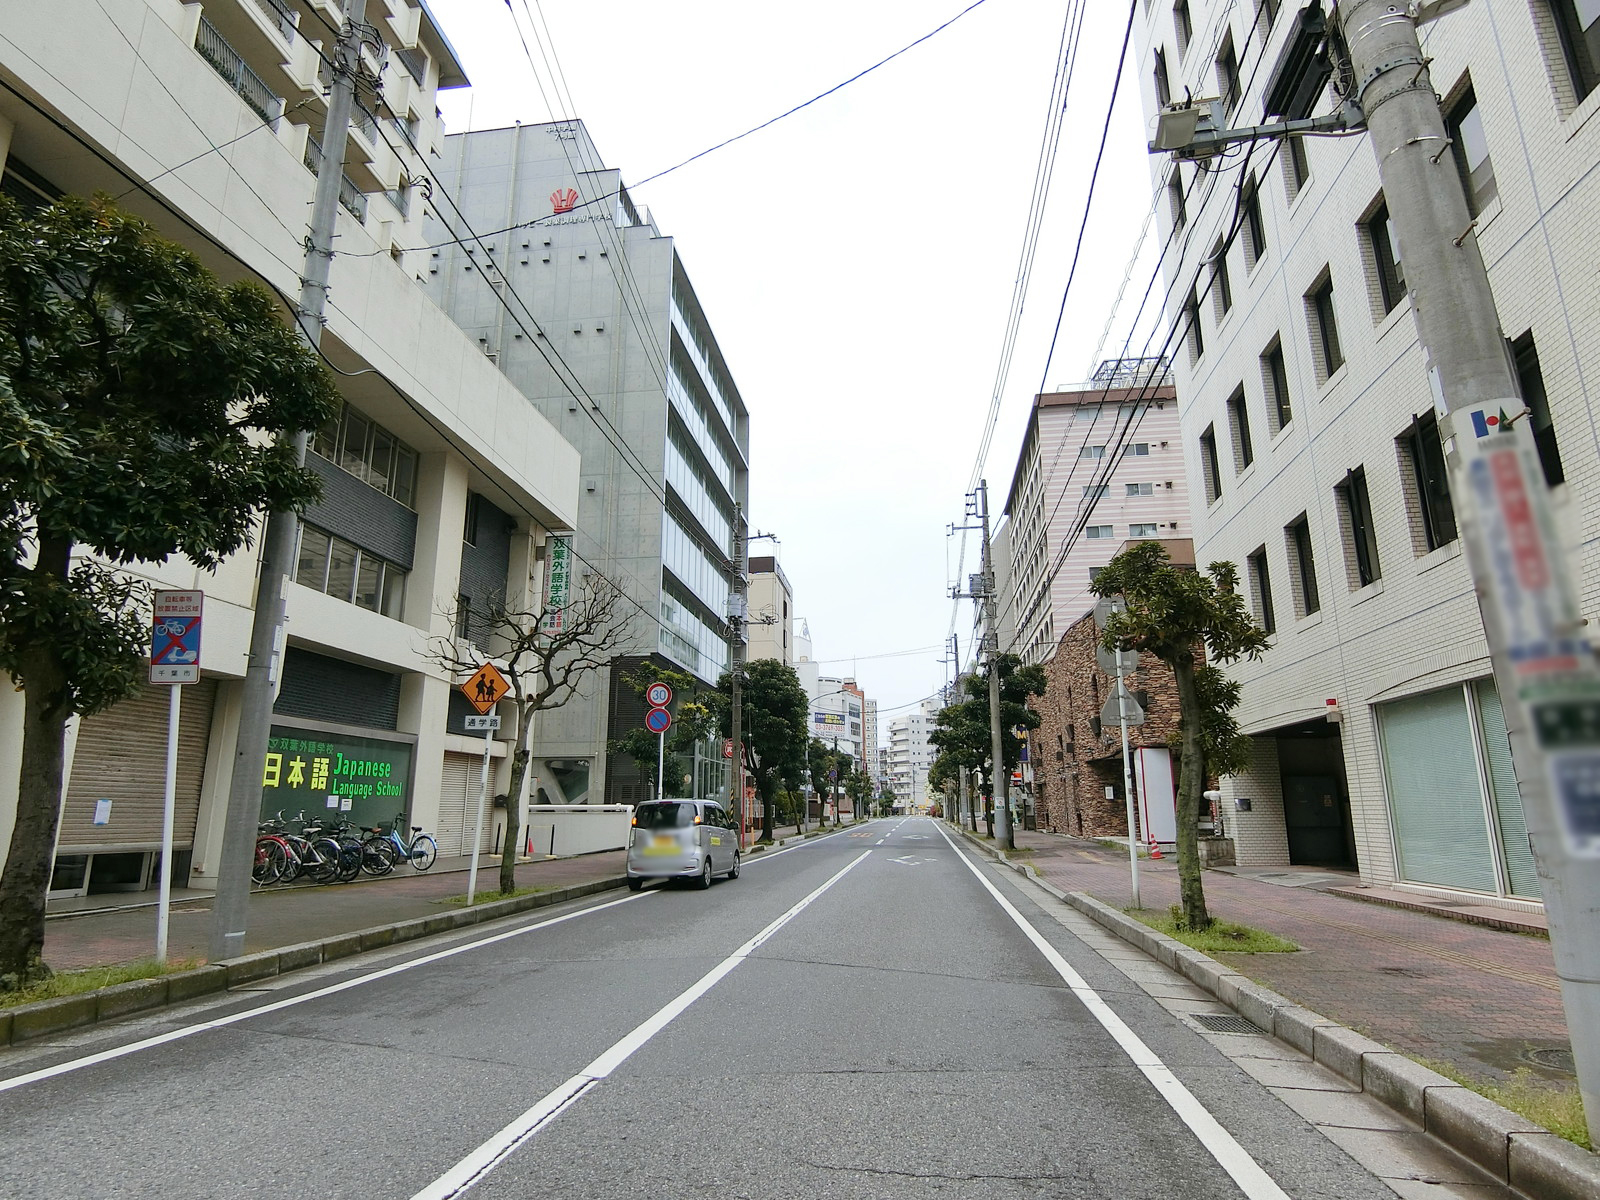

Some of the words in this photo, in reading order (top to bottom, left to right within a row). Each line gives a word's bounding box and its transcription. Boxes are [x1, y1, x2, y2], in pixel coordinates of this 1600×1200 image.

[550, 538, 565, 606] 双葉外語学校
[652, 689, 667, 701] 30
[467, 718, 498, 727] 通学路
[280, 737, 334, 755] 双葉外語学校
[263, 752, 330, 790] 日本語
[334, 753, 391, 780] Japanese
[333, 778, 372, 799] Language
[375, 780, 402, 797] School
